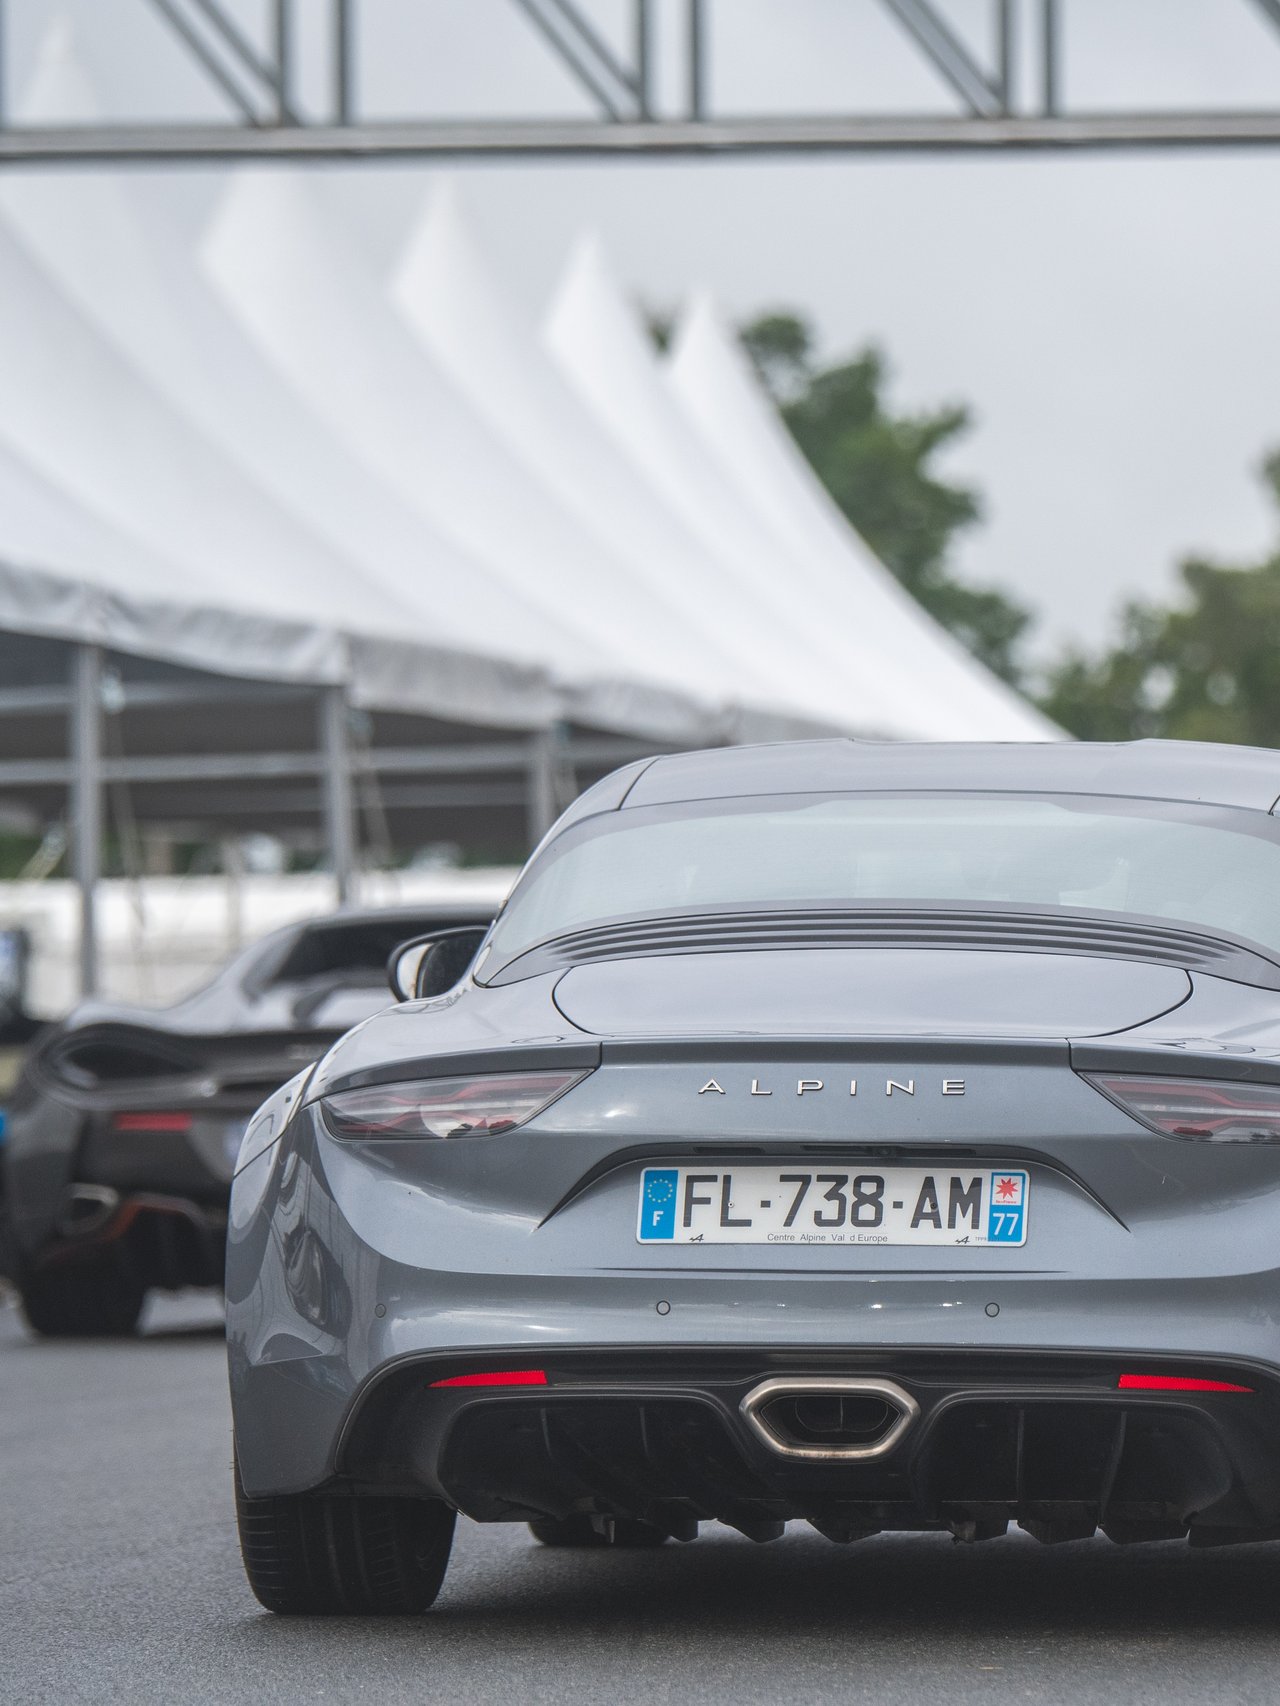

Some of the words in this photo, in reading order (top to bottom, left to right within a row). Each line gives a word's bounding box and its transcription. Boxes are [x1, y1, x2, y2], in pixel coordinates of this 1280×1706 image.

[698, 1077, 966, 1096] ALPINE
[682, 1174, 984, 1230] FL-738-AM
[652, 1211, 664, 1227] F
[993, 1213, 1019, 1236] 77
[767, 1233, 795, 1242] Centre
[800, 1233, 826, 1244] Alpine
[831, 1234, 845, 1242] Val
